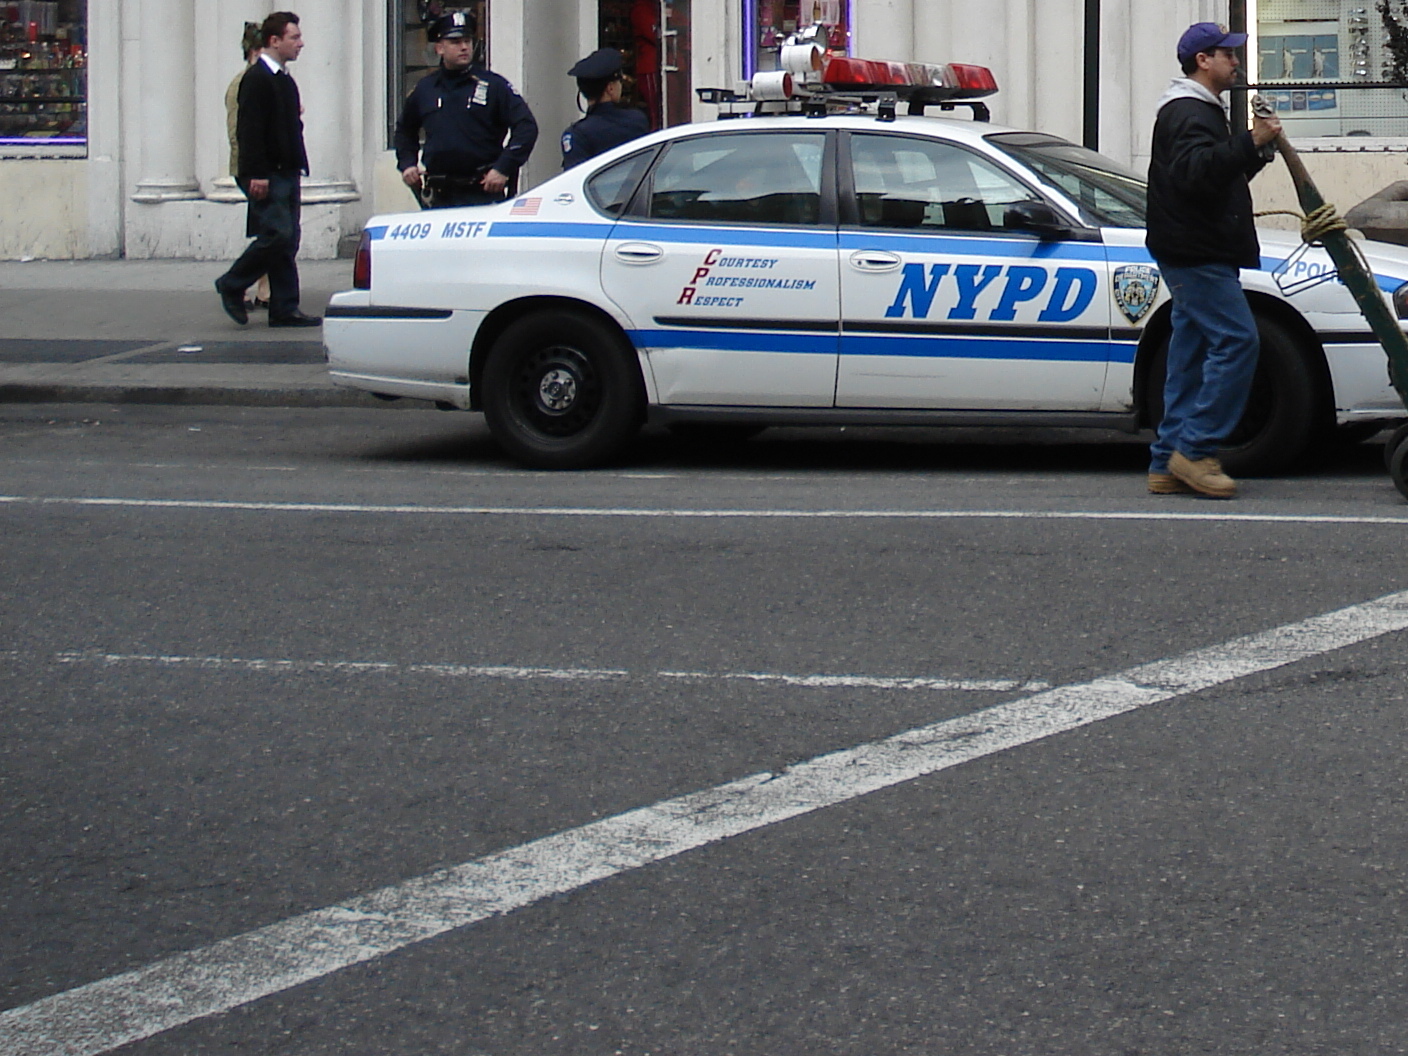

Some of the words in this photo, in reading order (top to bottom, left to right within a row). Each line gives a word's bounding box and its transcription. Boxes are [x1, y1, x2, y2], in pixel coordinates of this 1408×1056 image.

[390, 223, 432, 240] 4409
[441, 221, 487, 238] MSTF
[704, 248, 779, 269] COURTESY
[689, 267, 817, 290] PROFESSIONALISM
[676, 287, 744, 308] RESPECT
[884, 263, 1098, 323] NYPD
